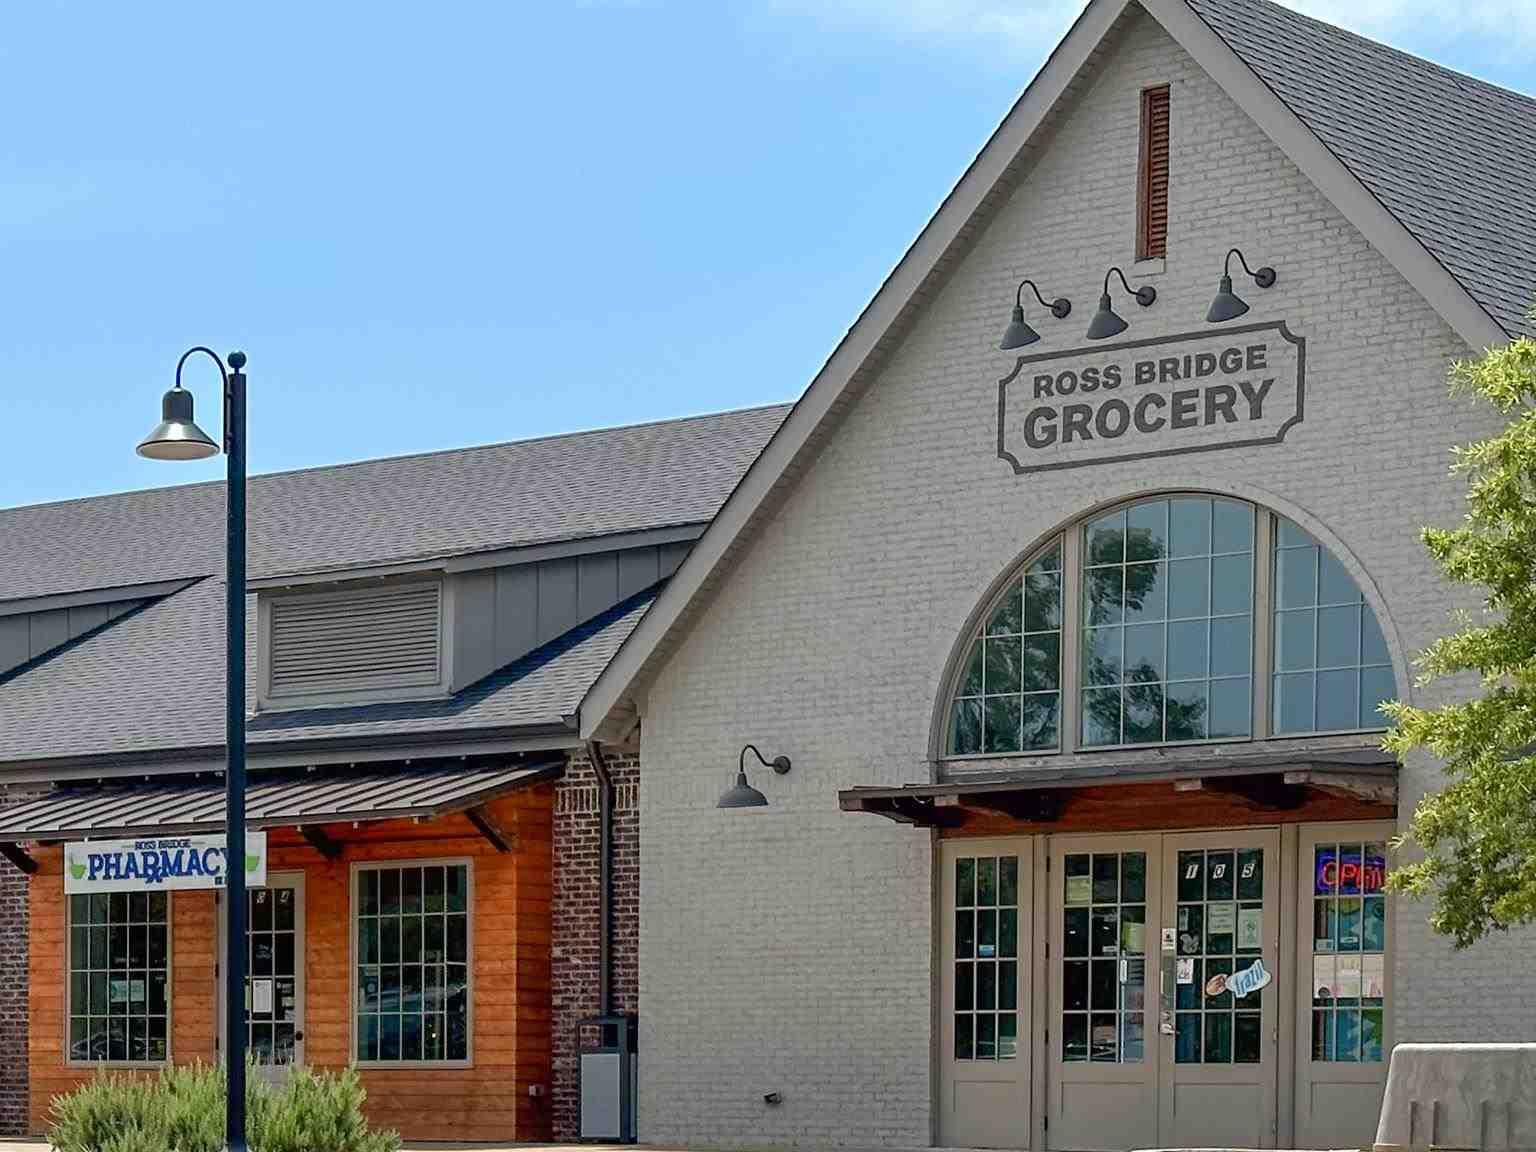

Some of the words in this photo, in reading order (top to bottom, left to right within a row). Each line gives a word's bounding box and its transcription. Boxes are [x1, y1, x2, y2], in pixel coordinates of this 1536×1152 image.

[1033, 365, 1121, 398] ROSS
[1135, 344, 1267, 385] BRIDGE
[1024, 378, 1275, 448] GROCERY
